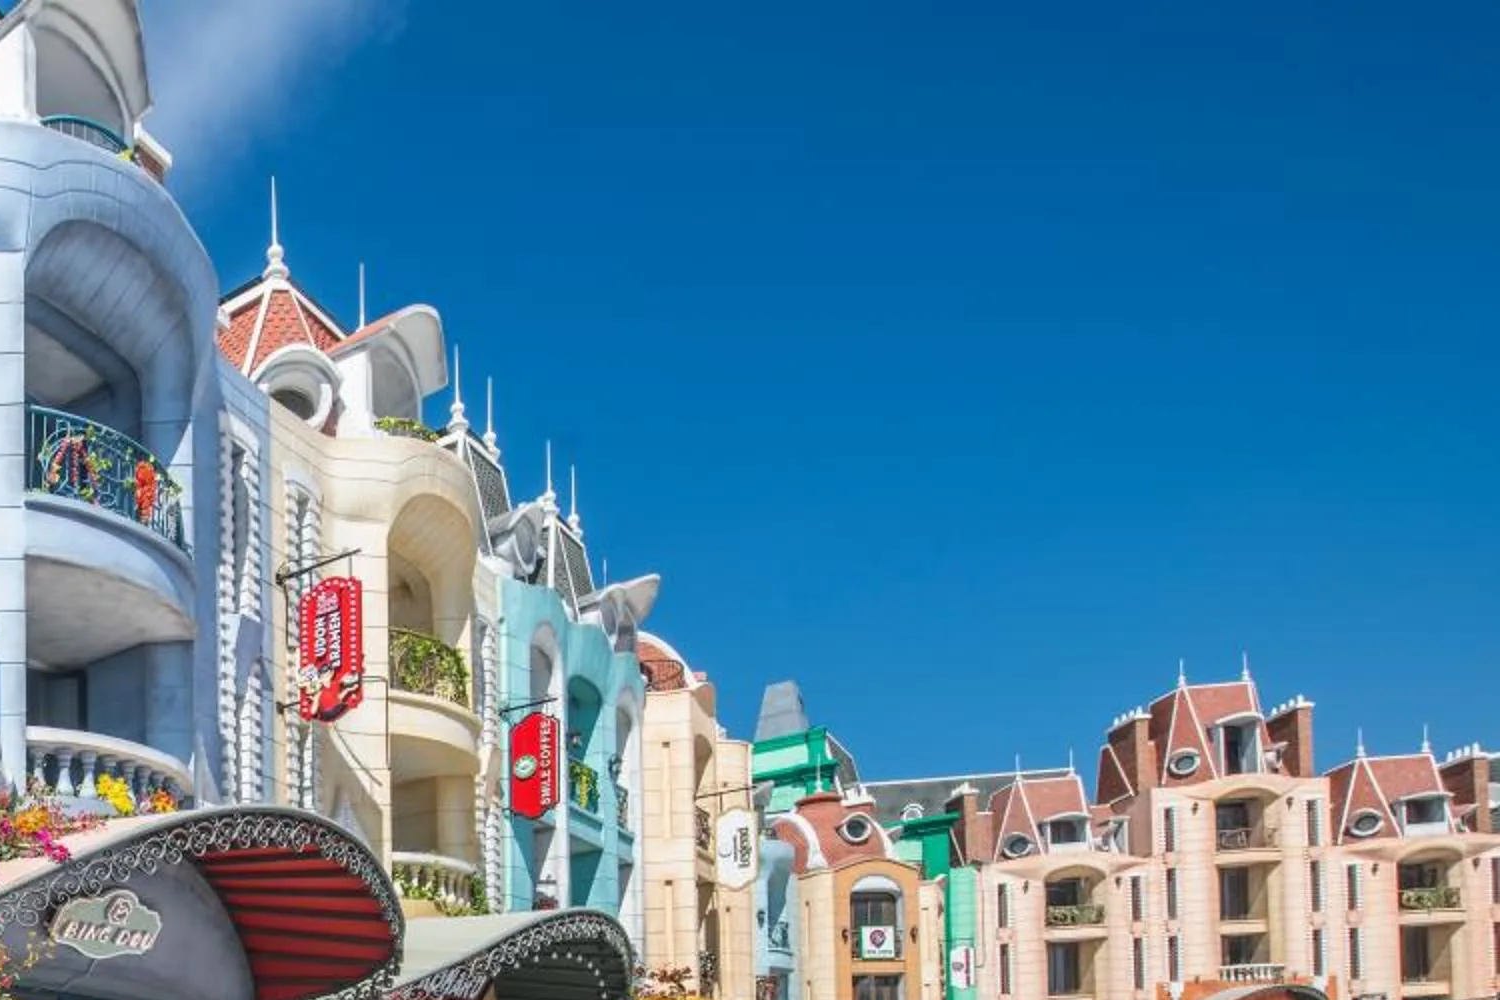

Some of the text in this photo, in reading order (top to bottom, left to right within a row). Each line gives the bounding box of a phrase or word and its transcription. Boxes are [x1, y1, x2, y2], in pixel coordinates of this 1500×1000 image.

[314, 615, 327, 657] UDON
[328, 611, 341, 661] RAMEN
[539, 717, 551, 805] SMILE COFFEE
[63, 920, 154, 950] BING DOU
